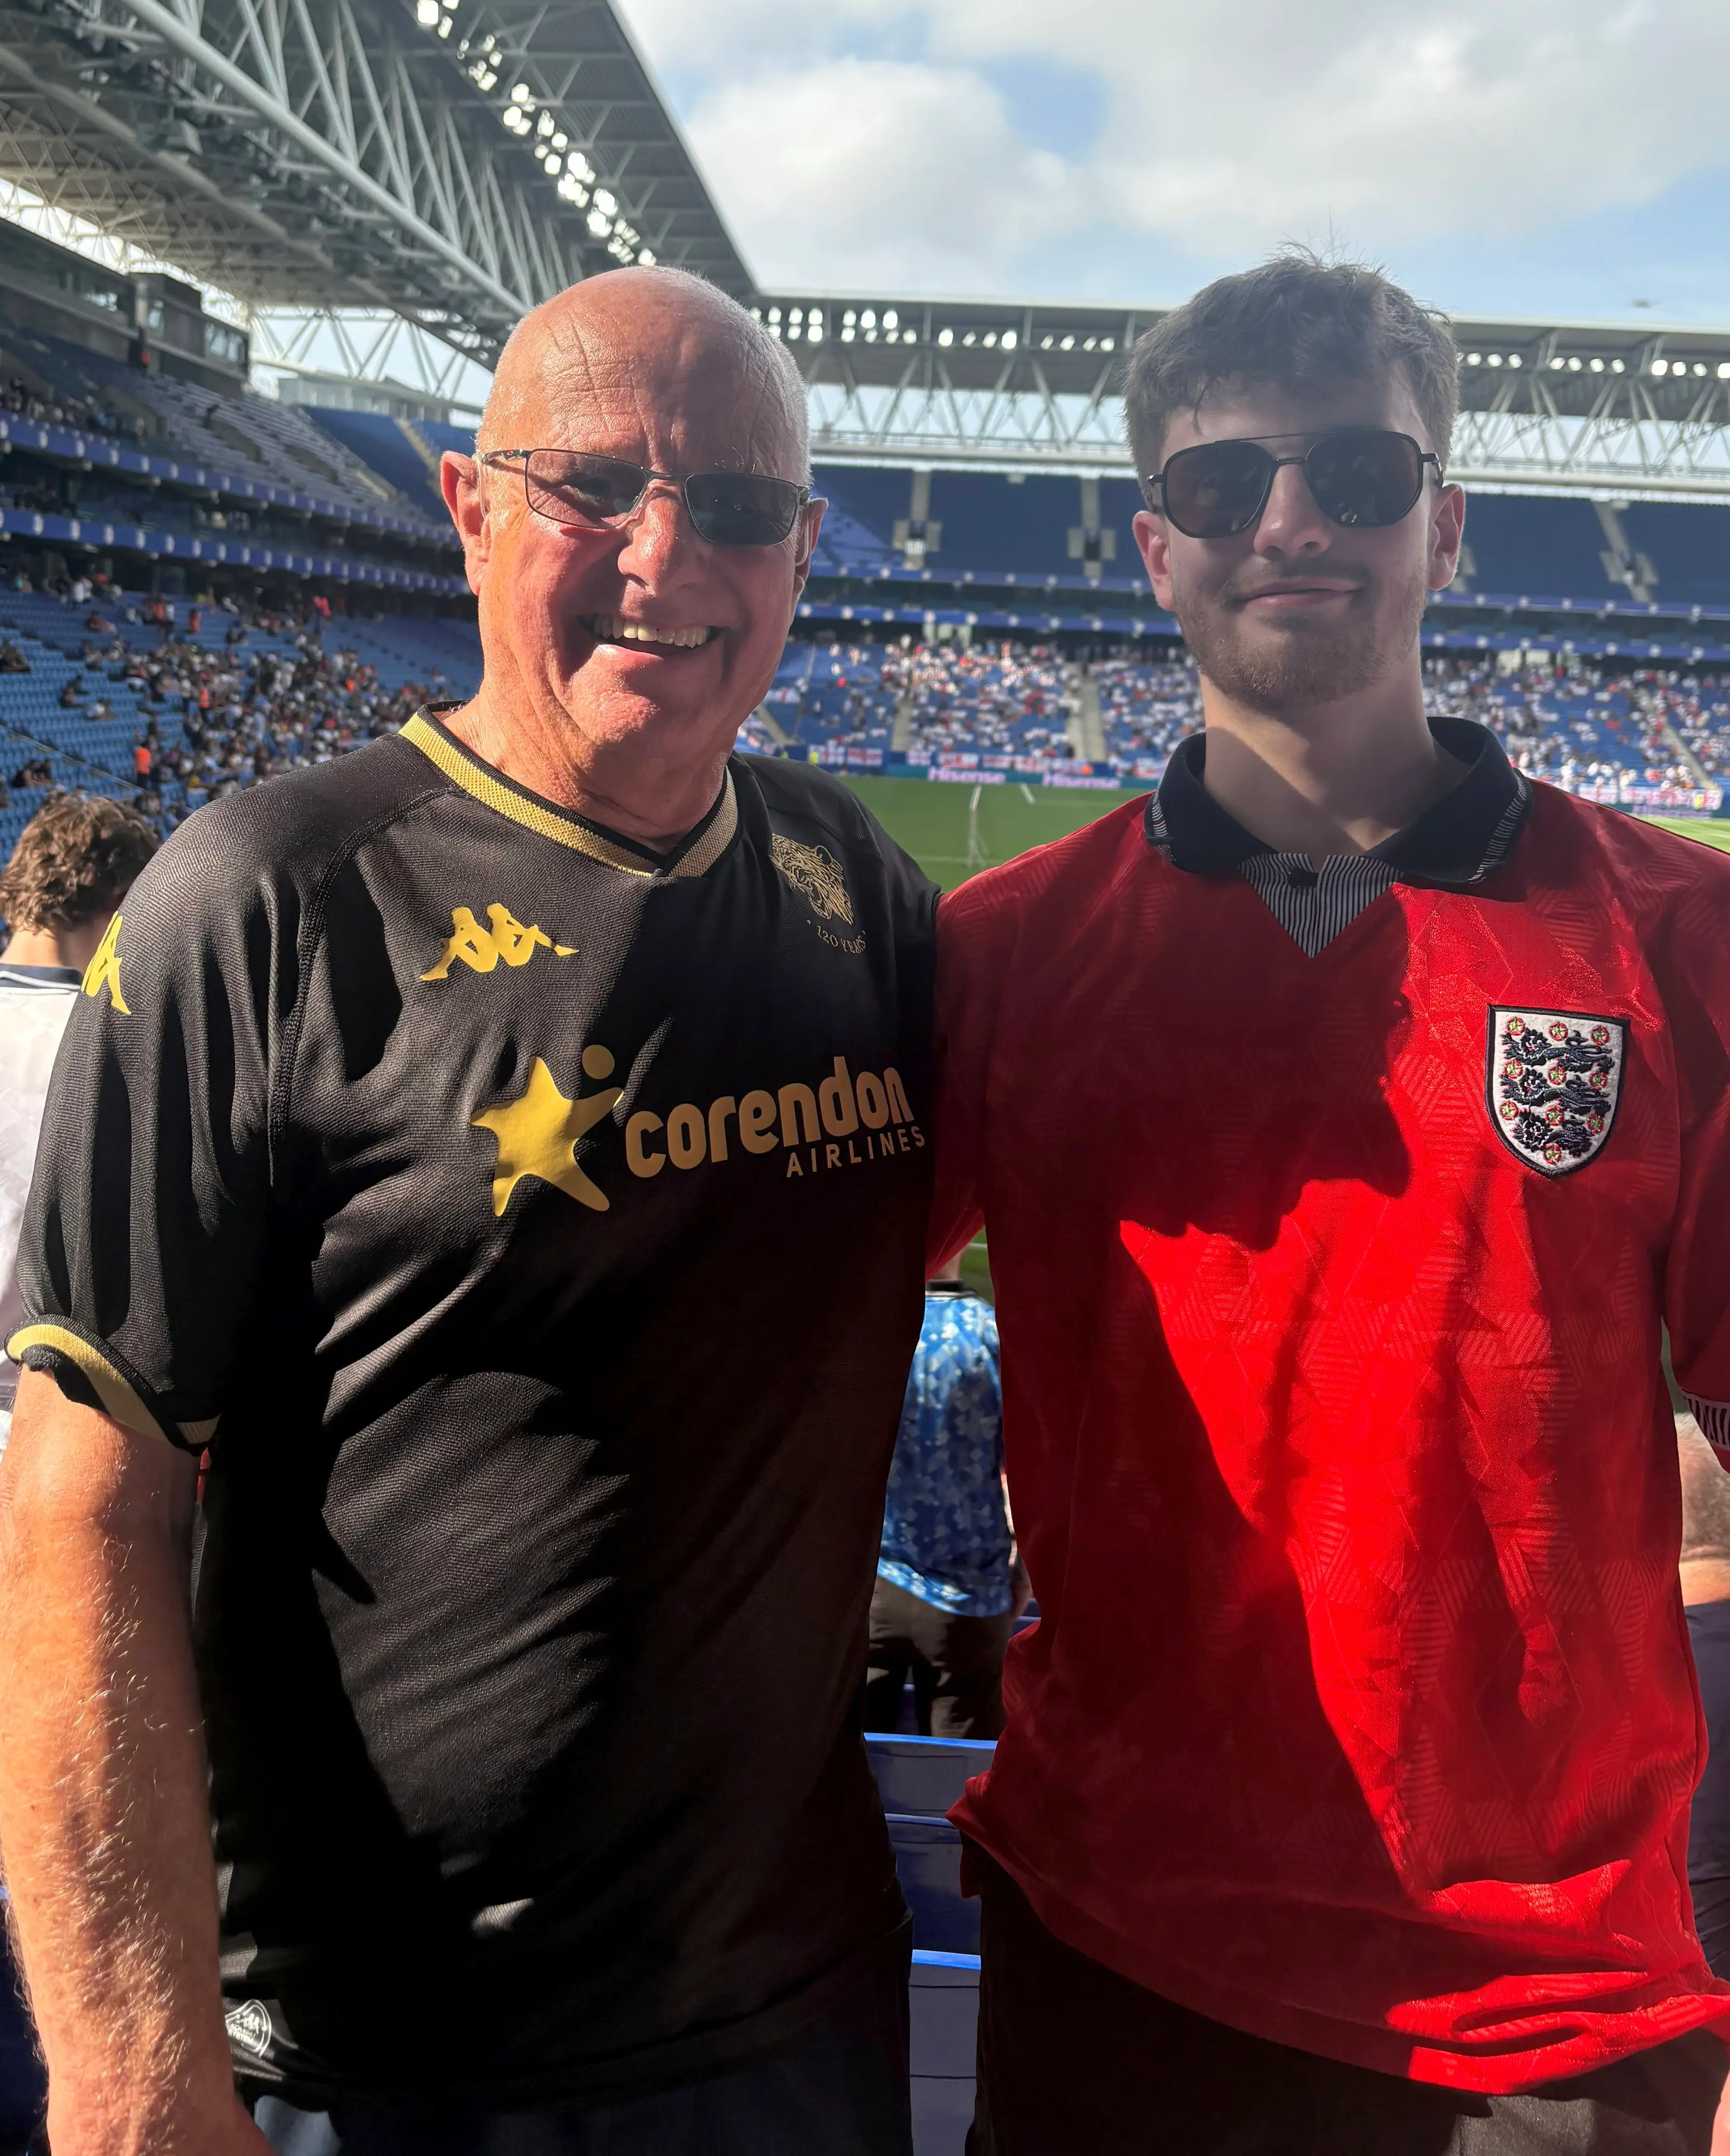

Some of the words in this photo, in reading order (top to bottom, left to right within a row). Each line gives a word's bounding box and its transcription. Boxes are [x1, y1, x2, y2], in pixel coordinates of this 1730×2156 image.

[928, 765, 1007, 784] Hisense
[817, 925, 838, 947] 120
[625, 1055, 914, 1178] corendon
[786, 1125, 925, 1178] AIRLINES
